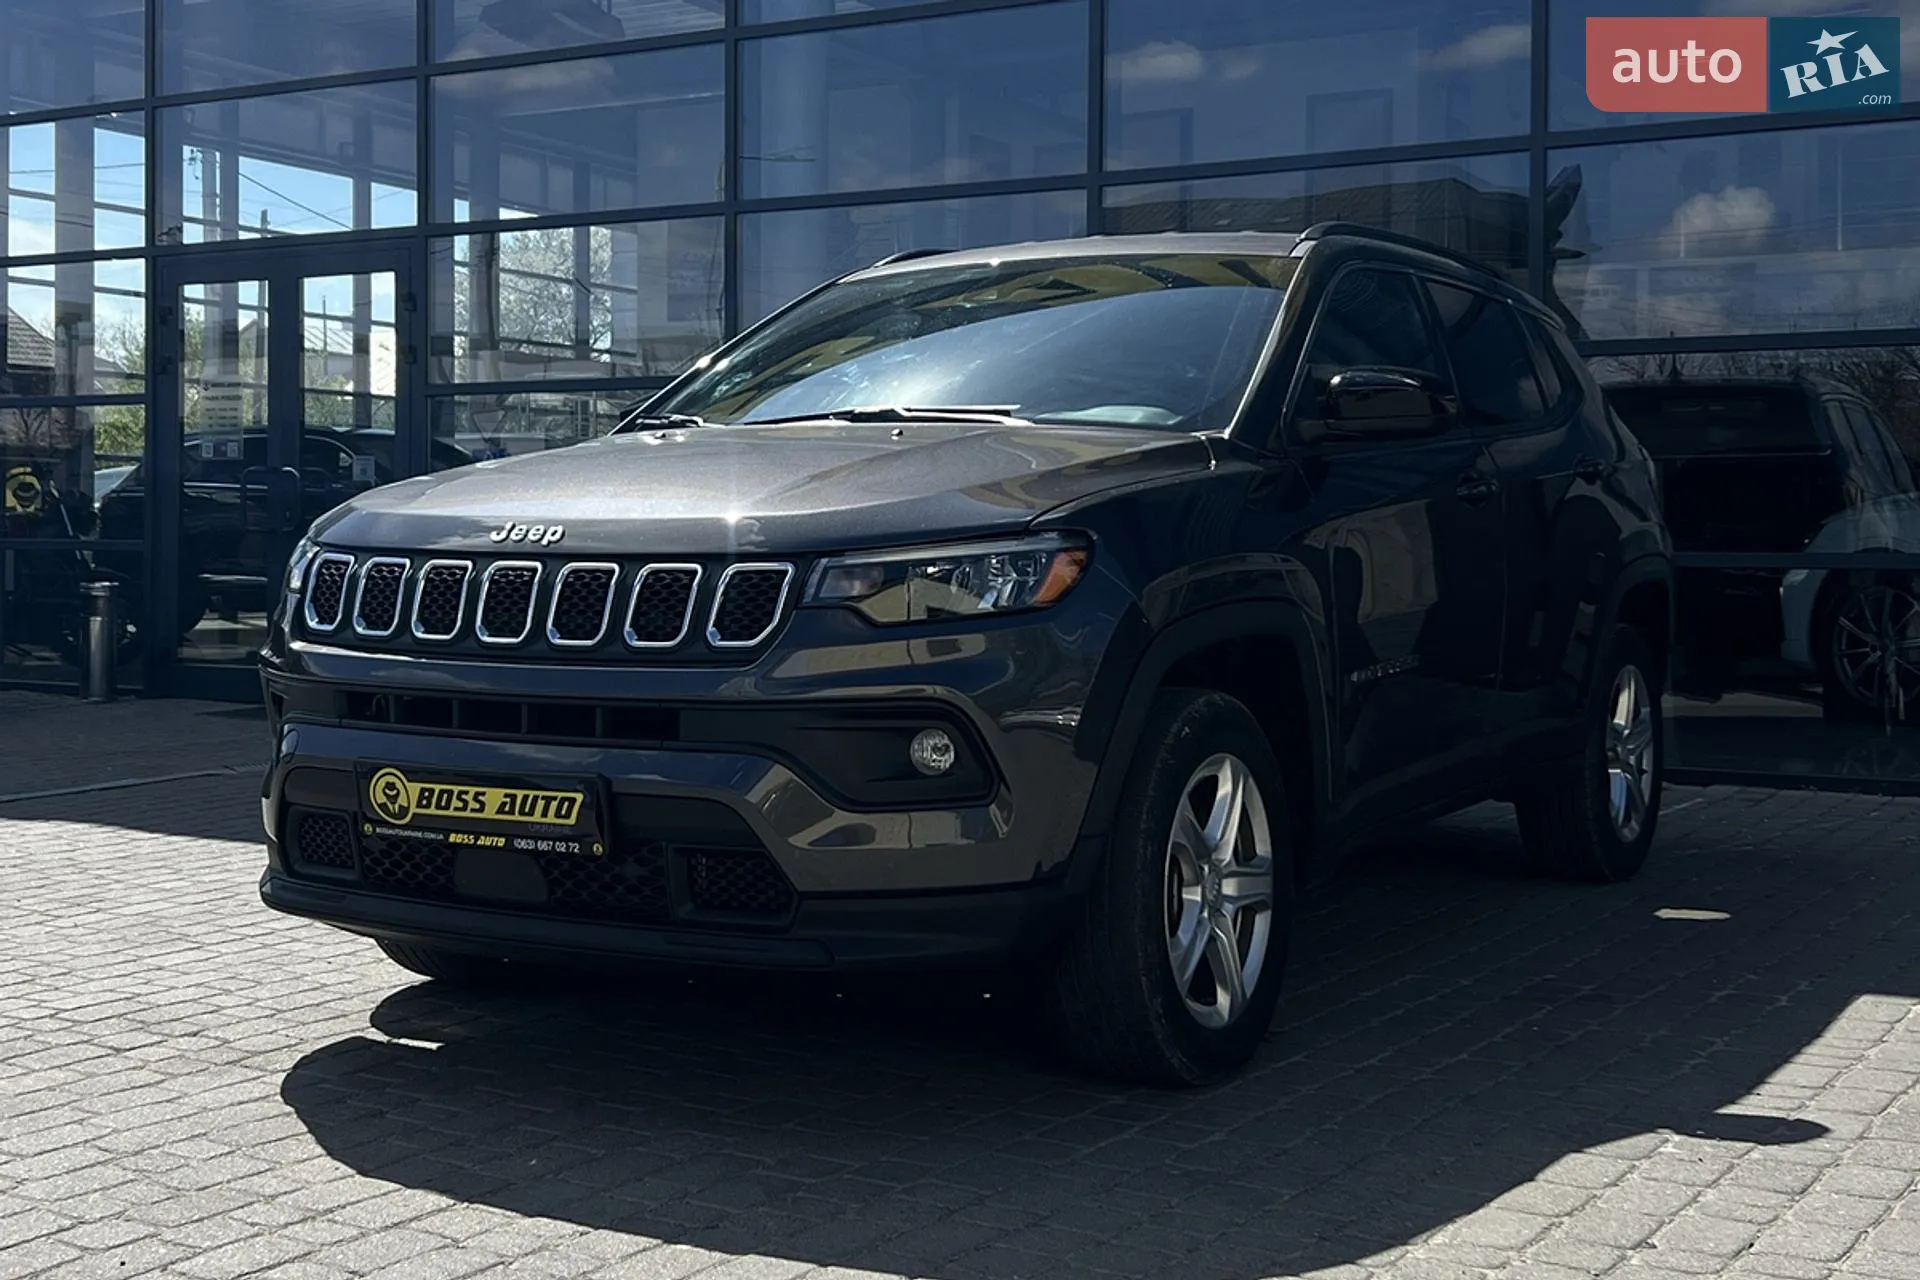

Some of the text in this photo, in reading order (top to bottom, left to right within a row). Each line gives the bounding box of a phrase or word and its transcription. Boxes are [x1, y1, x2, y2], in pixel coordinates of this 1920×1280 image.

[489, 521, 566, 547] Jeep
[417, 787, 577, 820] BOSS AUTO
[449, 833, 475, 844] BOSS
[477, 835, 506, 847] AUTO
[555, 841, 567, 852] 02
[569, 841, 580, 853] 72
